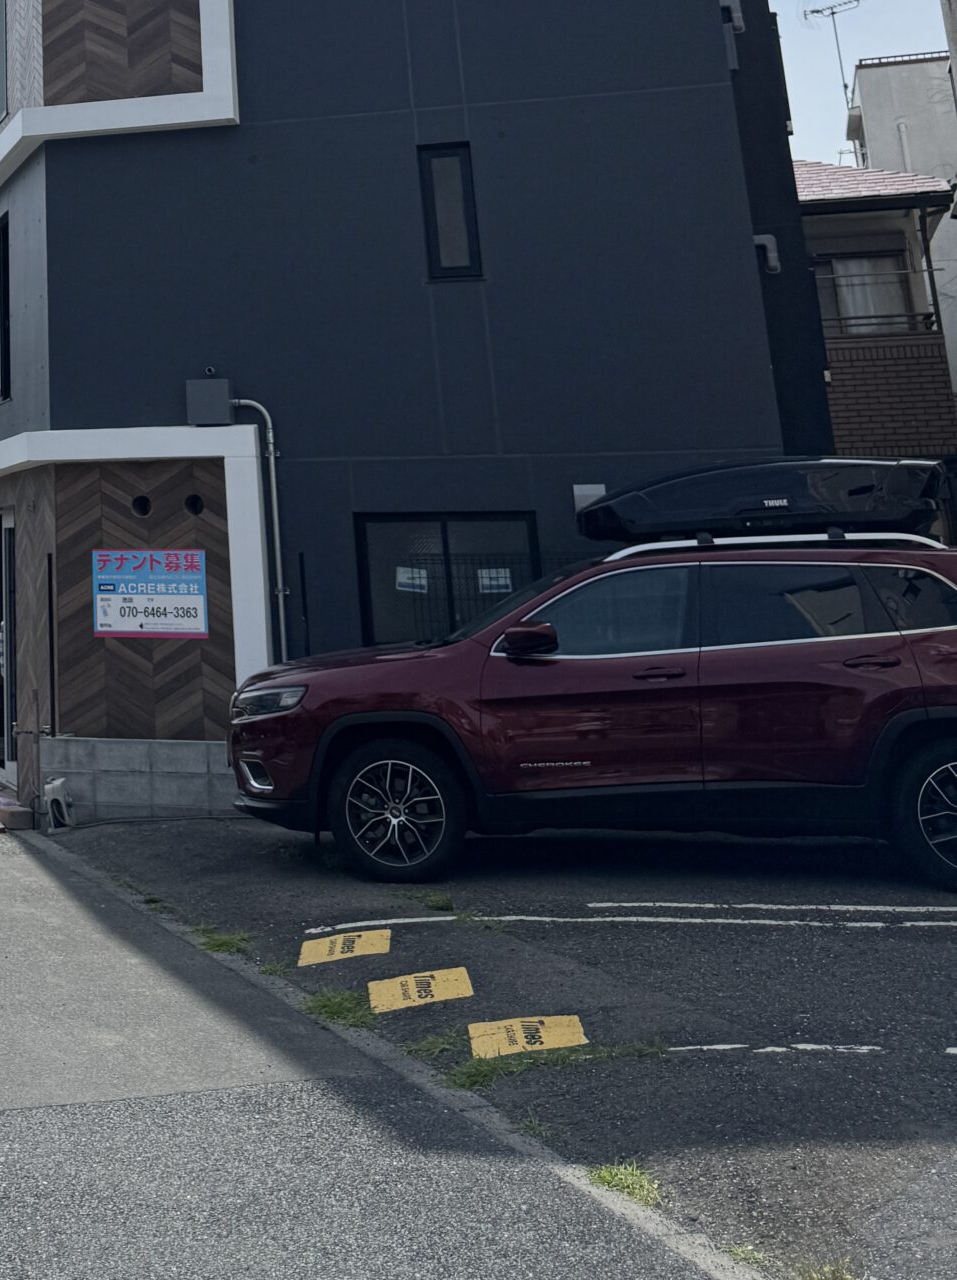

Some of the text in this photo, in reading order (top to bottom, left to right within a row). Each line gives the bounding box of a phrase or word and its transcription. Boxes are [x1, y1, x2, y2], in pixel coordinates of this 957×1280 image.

[763, 499, 789, 507] THULE
[97, 553, 201, 572] テナント募集
[118, 583, 199, 593] ACRE株式会社
[119, 606, 198, 618] 070-6464-3363
[340, 934, 362, 954] Times
[413, 974, 436, 999] Times
[520, 1020, 545, 1045] Times
